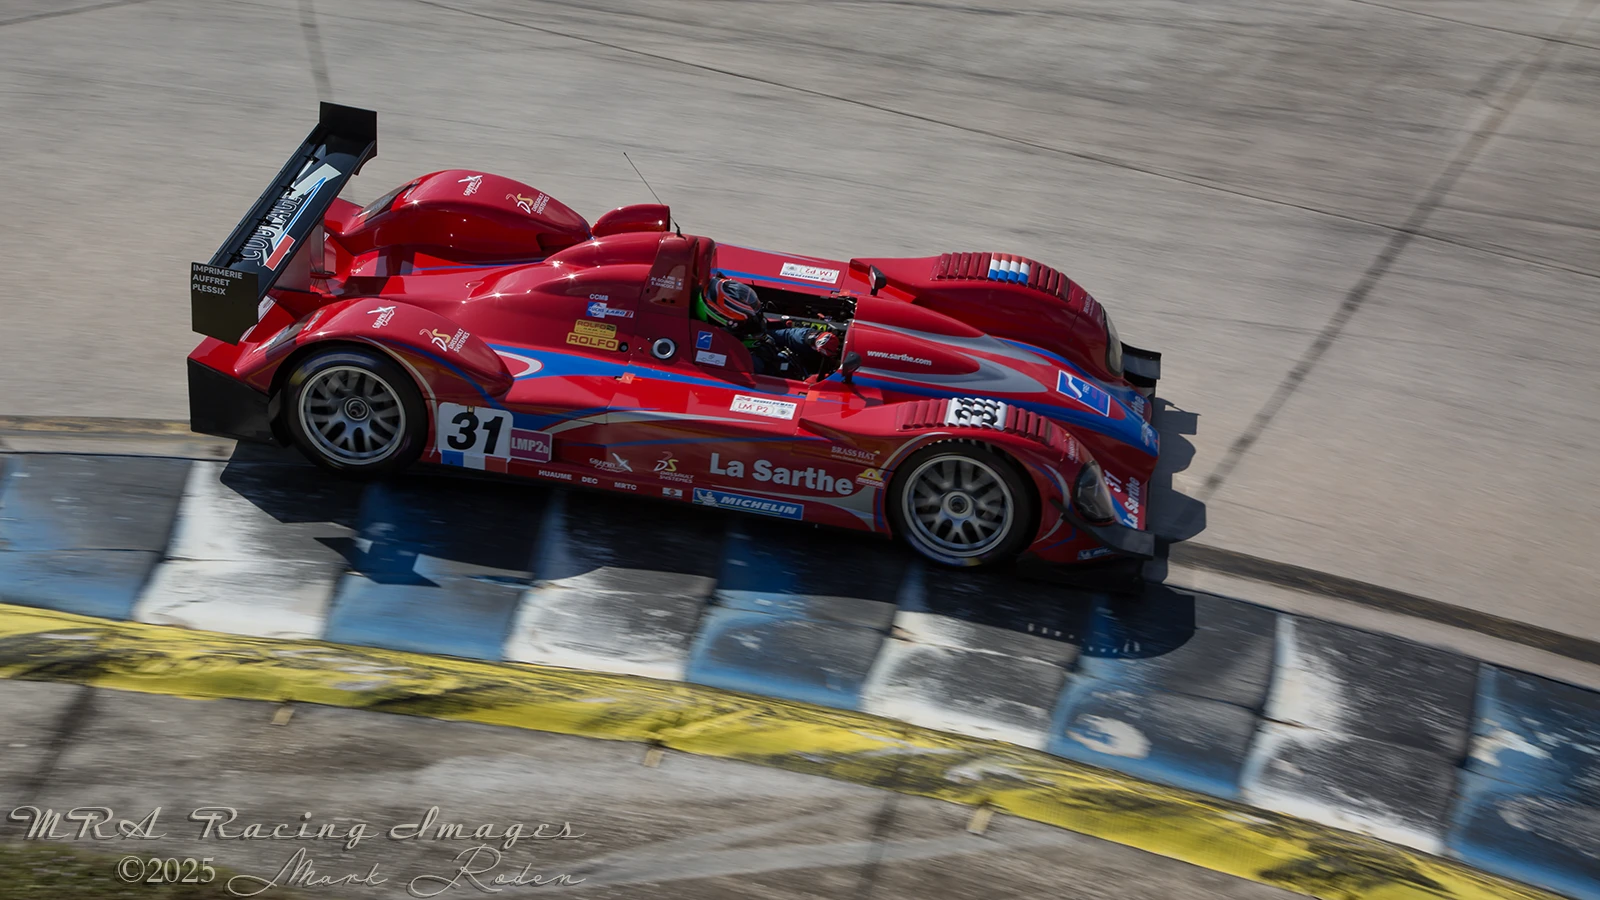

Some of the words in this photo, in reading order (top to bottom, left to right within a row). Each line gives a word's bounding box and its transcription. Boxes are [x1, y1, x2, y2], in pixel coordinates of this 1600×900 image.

[193, 265, 243, 280] IMPRIMERIE
[193, 274, 230, 287] AUFFRET
[192, 284, 226, 296] PLESSIX
[577, 320, 608, 330] ROLFO
[568, 334, 617, 349] ROLFO
[867, 349, 932, 366] www.sarthe.com
[738, 402, 753, 410] LM
[756, 405, 769, 413] P2
[447, 411, 504, 455] 31
[831, 446, 857, 457] BRASS
[857, 451, 876, 461] HAT
[538, 469, 573, 480] HUAUME
[581, 476, 598, 485] DEC
[660, 470, 695, 479] DASSAULT
[710, 453, 744, 478] La
[752, 460, 854, 495] Sarthe
[1103, 469, 1122, 493] 31
[614, 481, 637, 491] MRTC
[1124, 476, 1140, 514] Sarthe
[720, 495, 797, 515] MICHELIN
[1123, 513, 1139, 529] La
